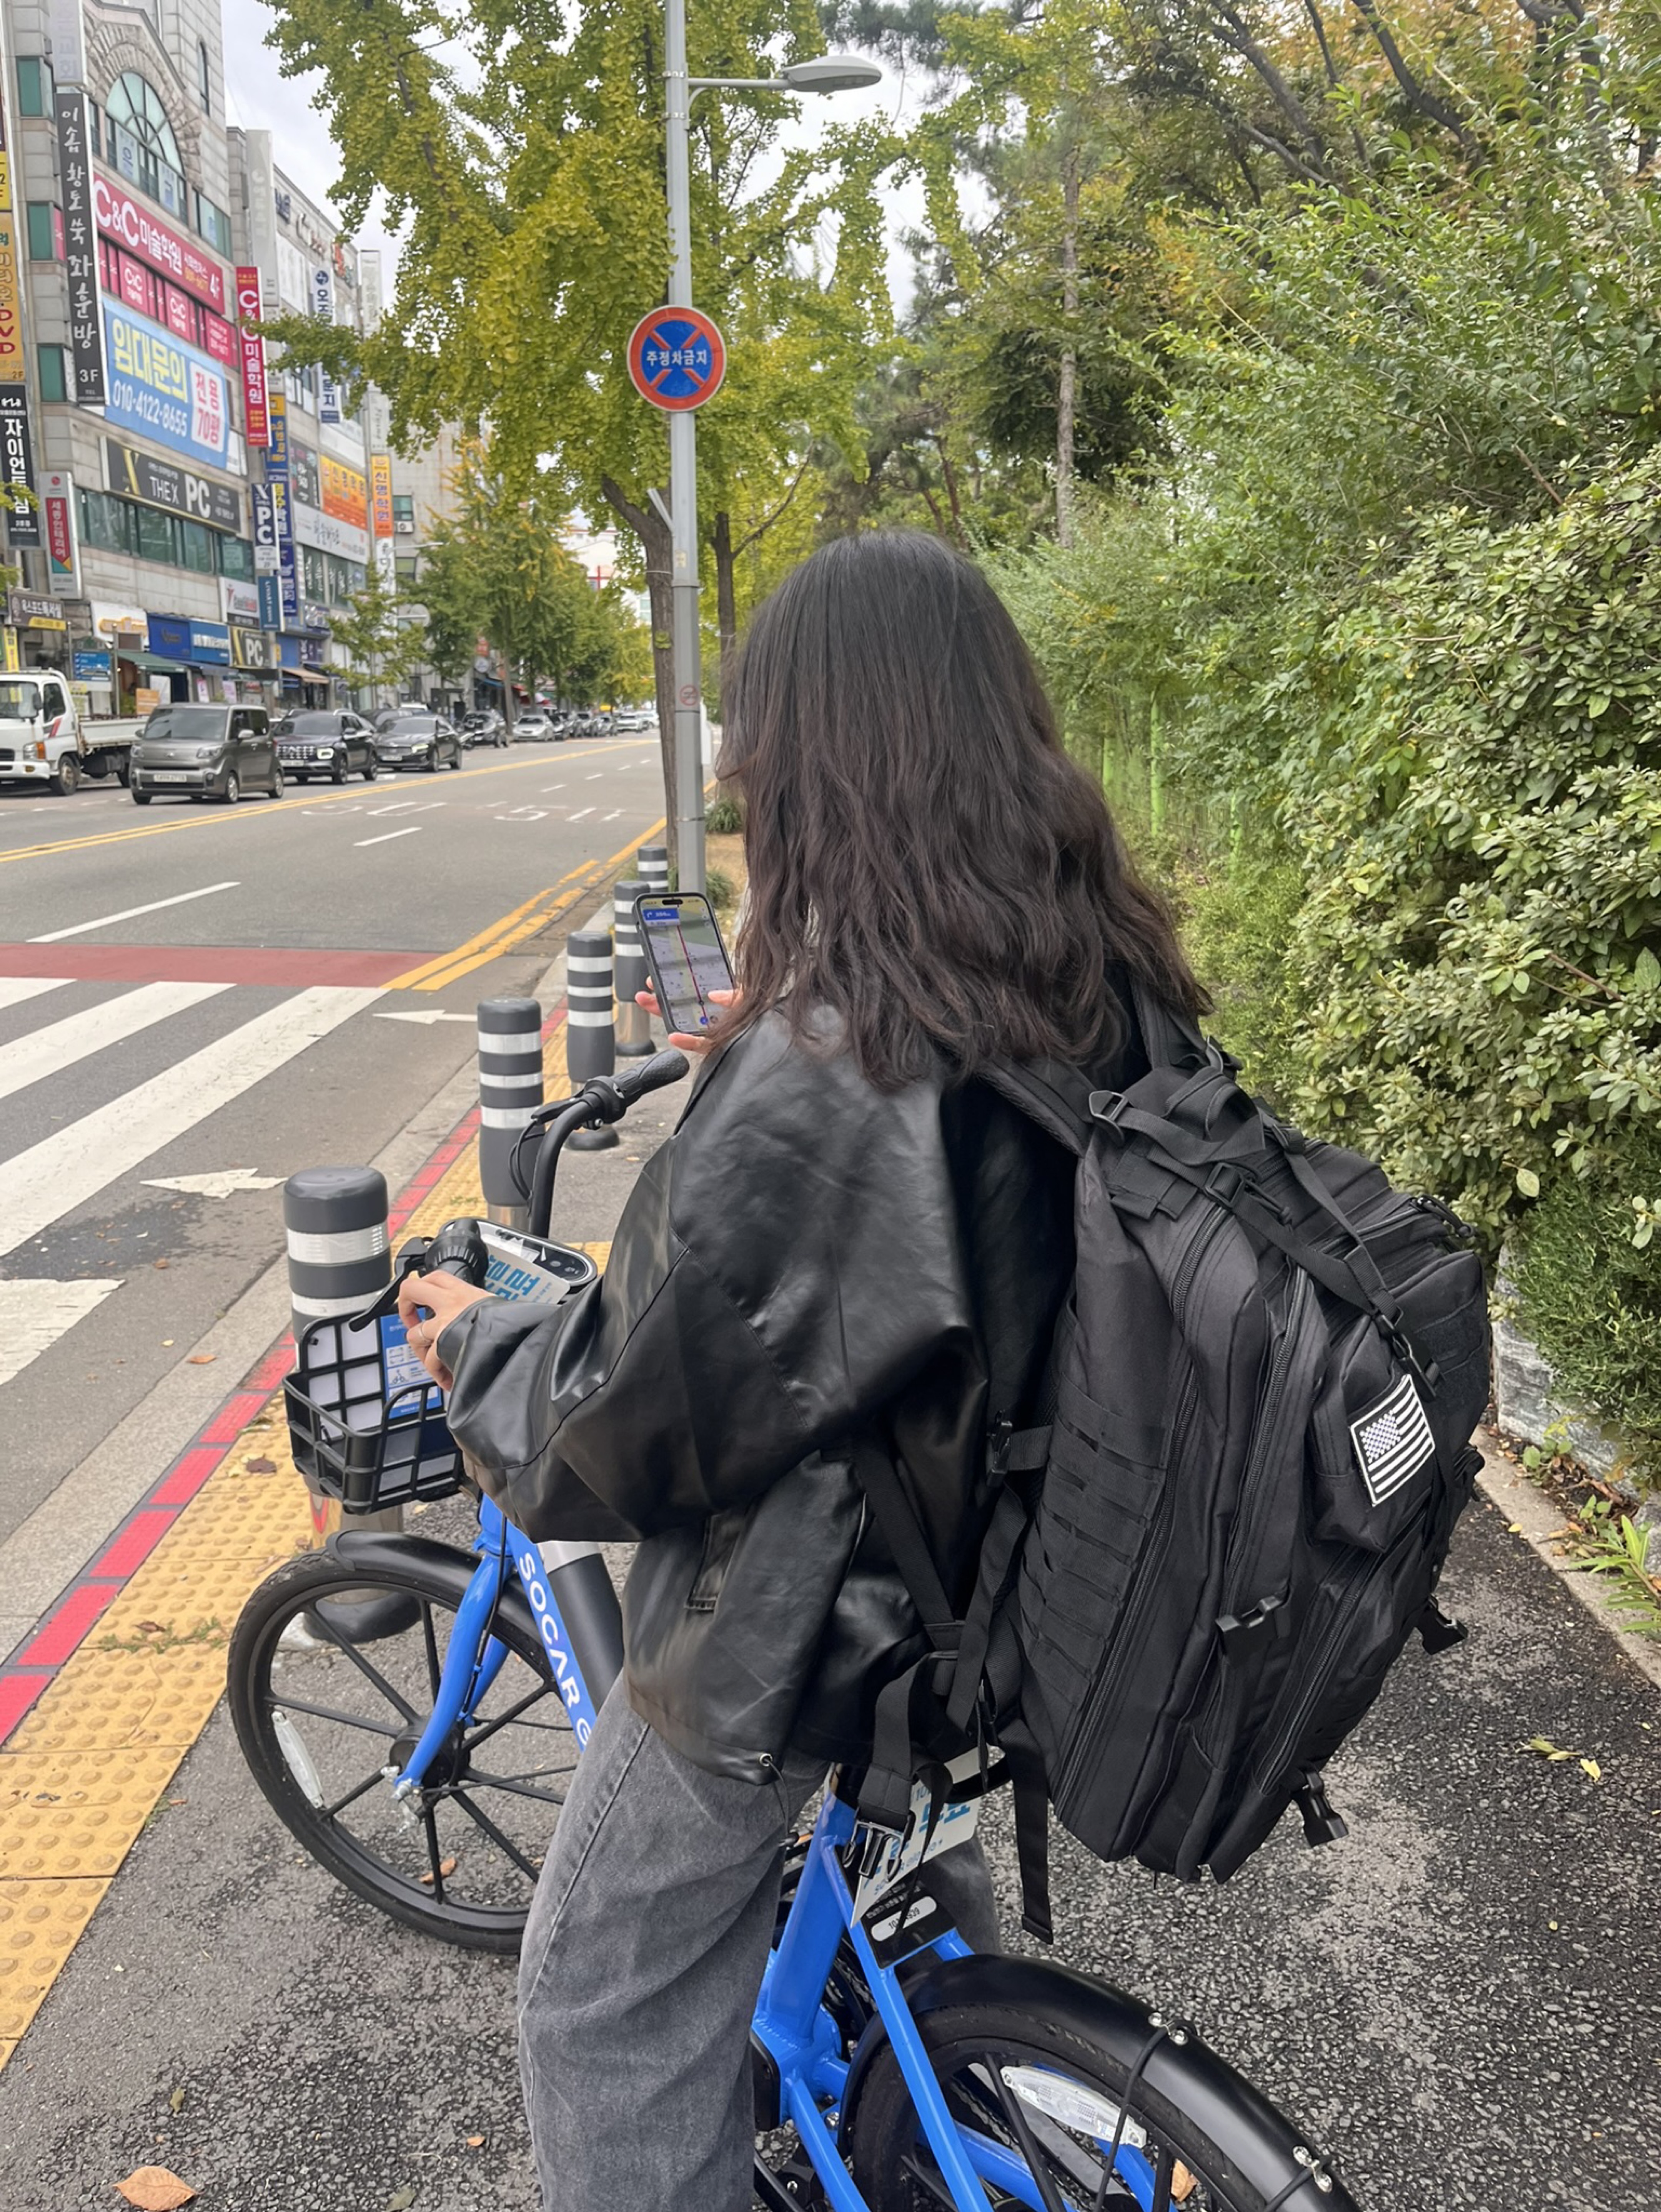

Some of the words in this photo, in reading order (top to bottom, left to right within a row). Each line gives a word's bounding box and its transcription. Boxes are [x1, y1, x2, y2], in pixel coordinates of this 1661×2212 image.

[93, 180, 139, 247] C&C
[140, 218, 183, 276] 미술학원
[79, 369, 98, 383] 3F
[112, 318, 189, 403] 임대문의
[244, 343, 263, 404] 미술학원
[646, 349, 707, 366] 주정차금지
[113, 379, 187, 437] 010-4122-8655
[195, 372, 220, 411] 전용
[197, 407, 220, 445] 70평
[184, 473, 211, 518] PC
[256, 506, 273, 545] PC
[245, 638, 264, 667] PC
[519, 1552, 581, 1709] SOCAR
